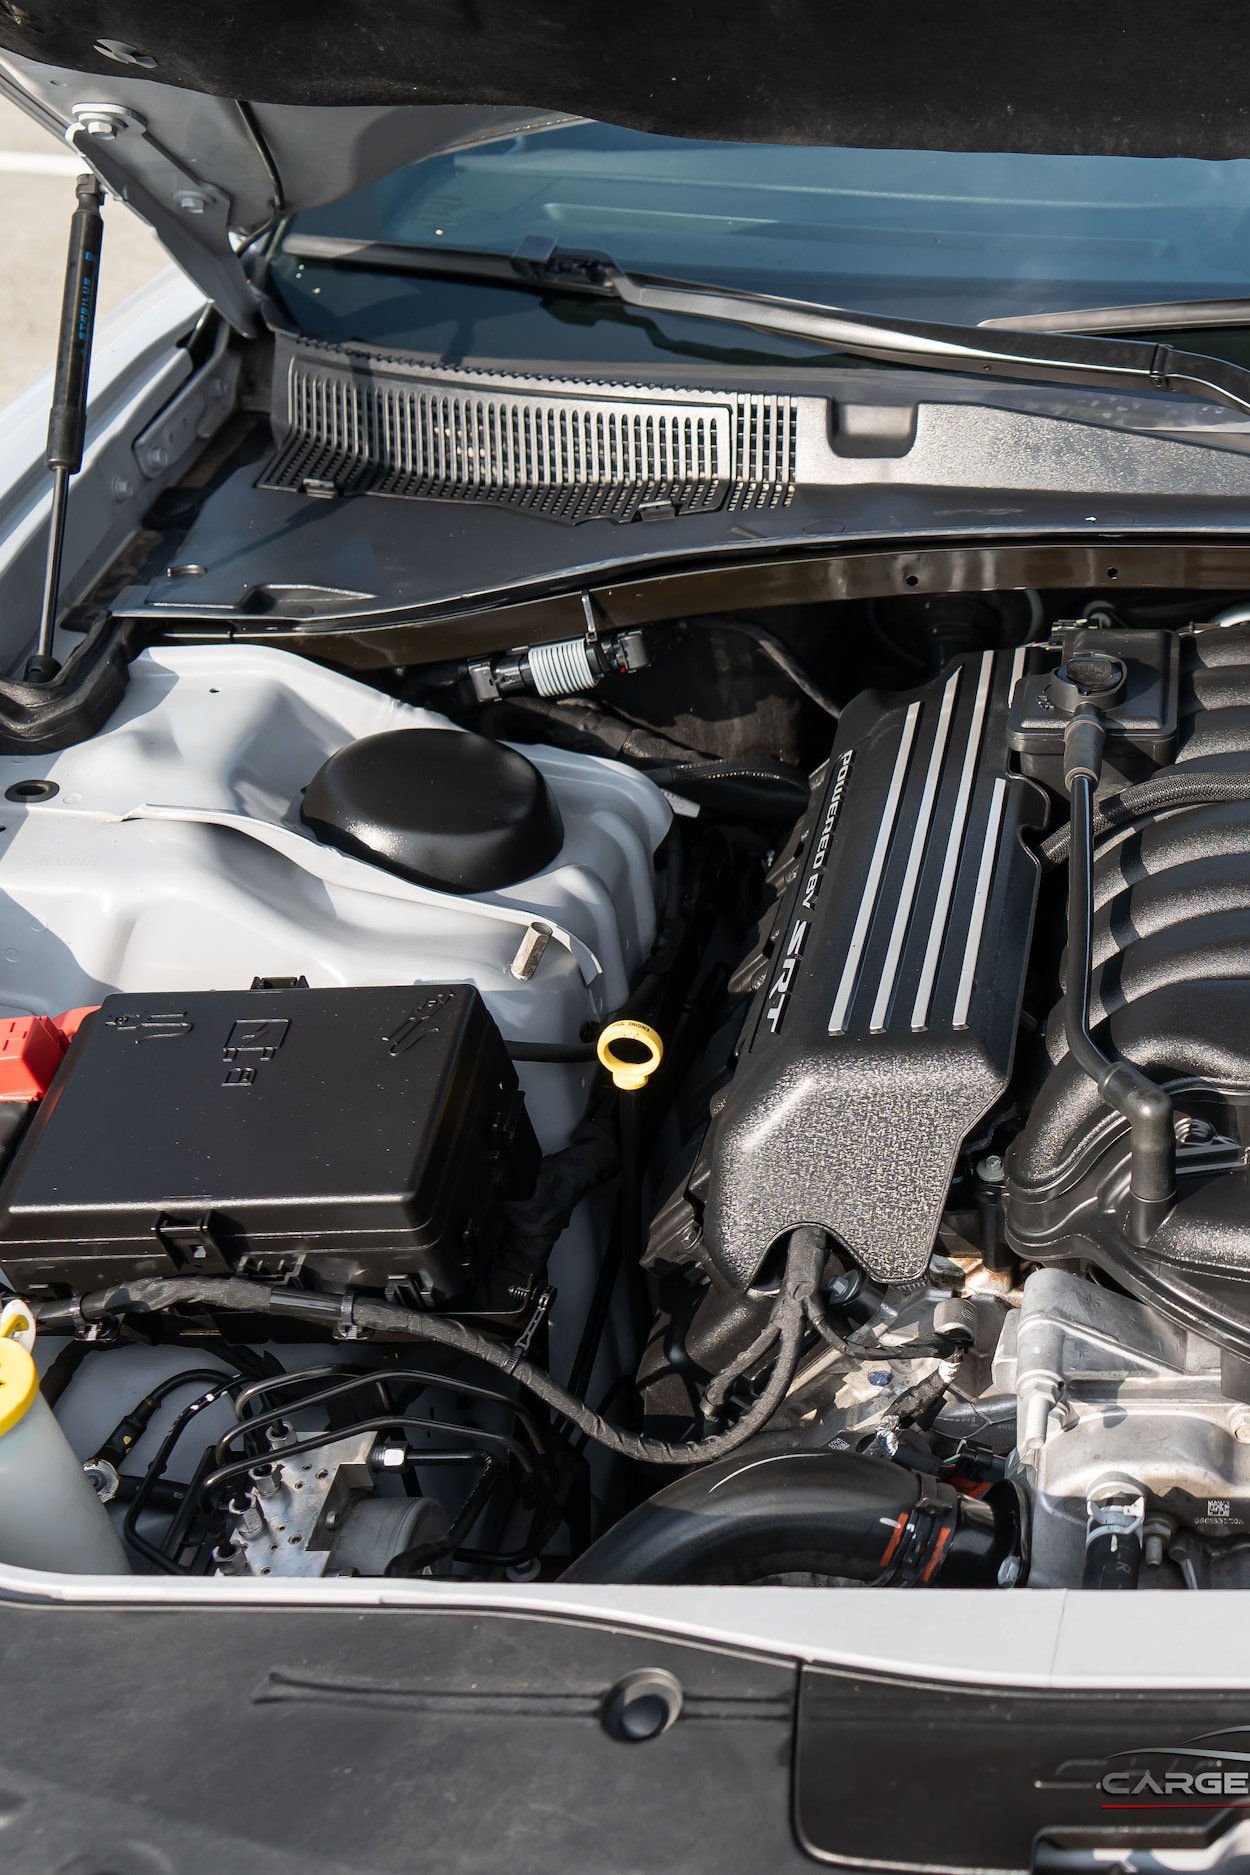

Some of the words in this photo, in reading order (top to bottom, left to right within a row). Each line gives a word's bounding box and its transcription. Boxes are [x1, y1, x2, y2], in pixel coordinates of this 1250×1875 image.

[811, 749, 853, 870] POWERED
[802, 873, 822, 910] BY
[767, 919, 807, 1034] SRT
